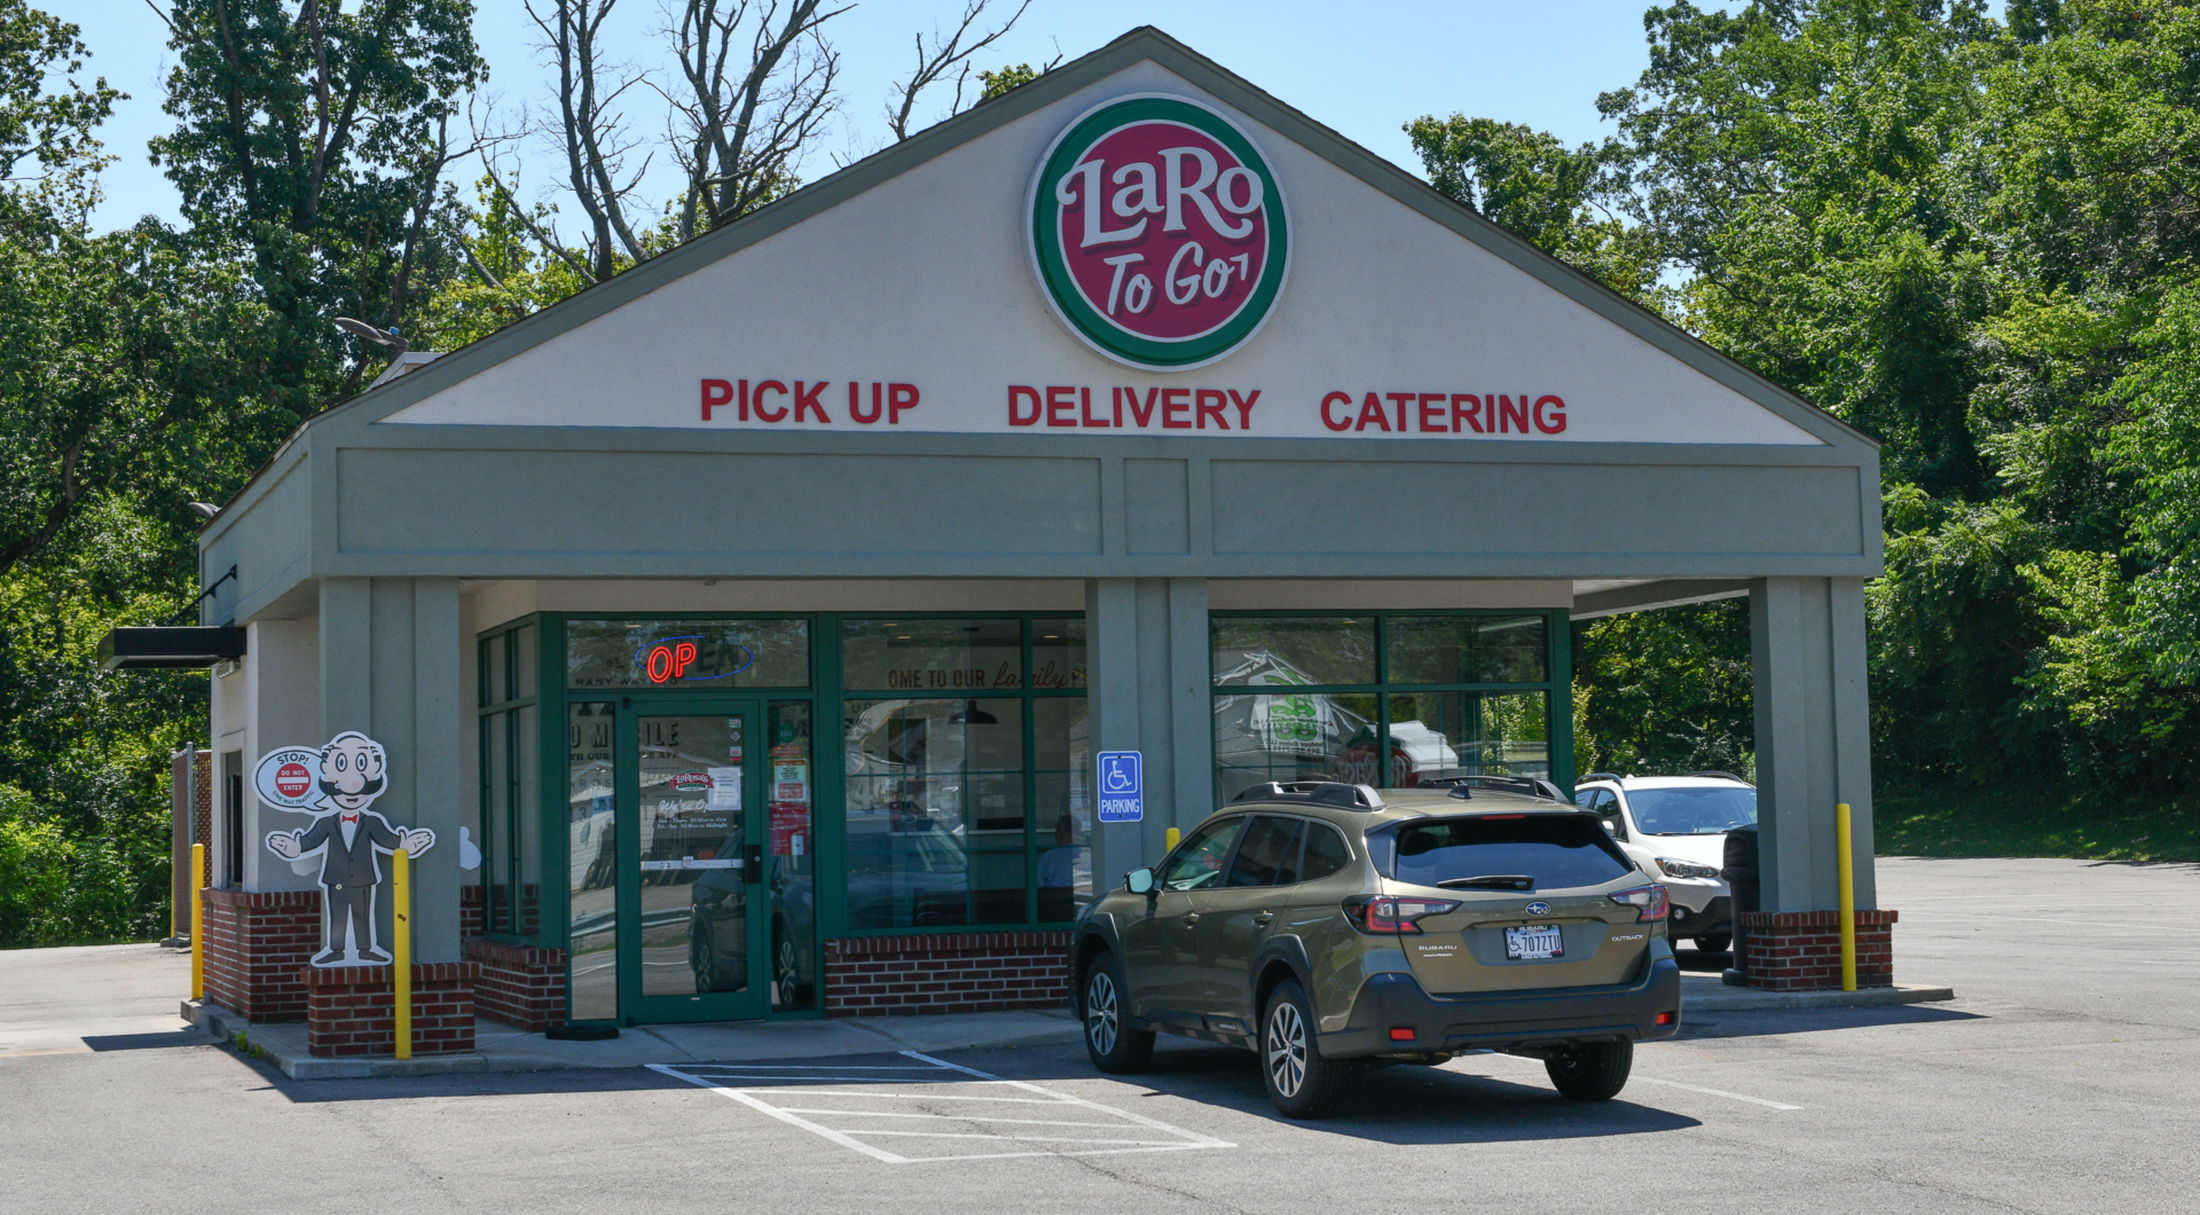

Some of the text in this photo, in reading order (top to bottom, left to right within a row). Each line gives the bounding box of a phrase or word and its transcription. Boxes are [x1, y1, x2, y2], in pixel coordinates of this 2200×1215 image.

[1056, 146, 1264, 248] LaRo
[1104, 241, 1236, 315] To Go
[700, 379, 920, 424] PICK UP
[1007, 385, 1262, 430] DELIVERY
[1320, 391, 1567, 435] CATERING
[928, 669, 946, 688] TO
[953, 669, 985, 687] OUR
[277, 753, 310, 765] STOP!
[588, 752, 610, 761] OUR
[295, 789, 315, 805] TRAFFIC
[1101, 798, 1140, 814] PARKING
[1611, 934, 1644, 942] OUTBACK
